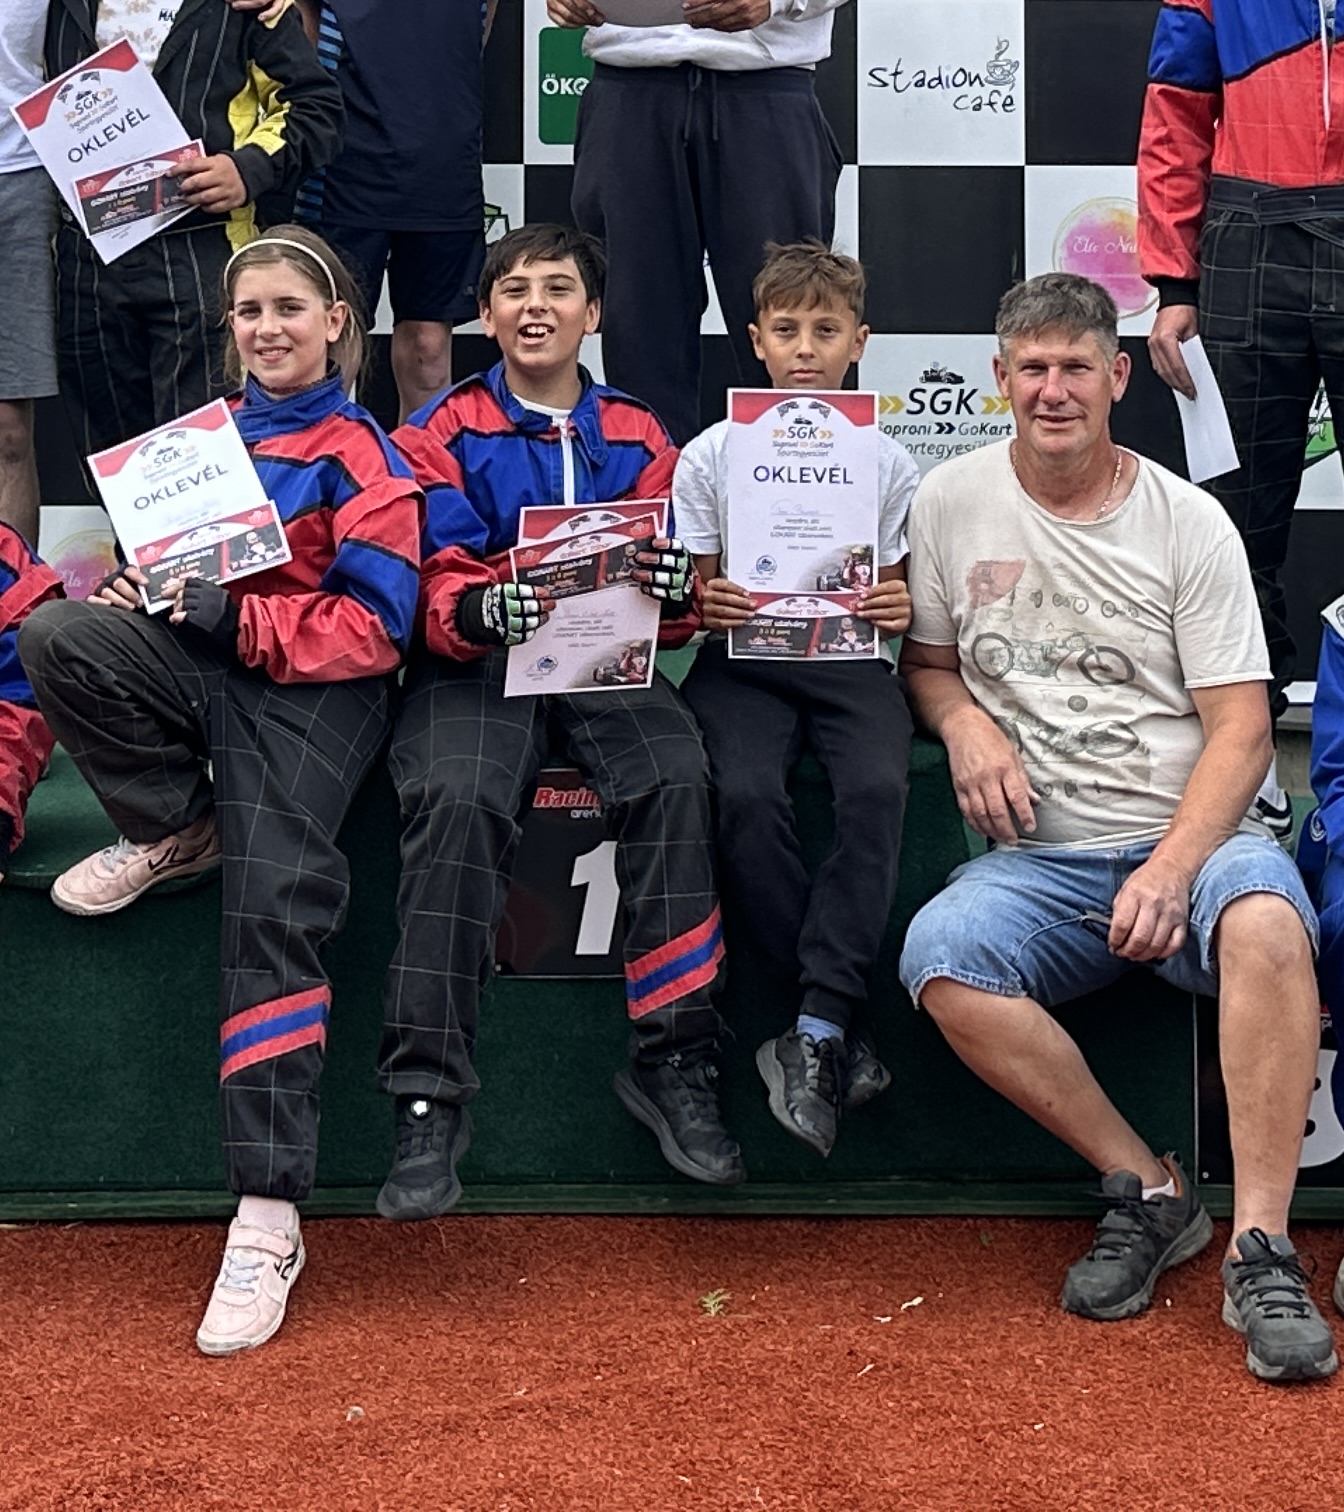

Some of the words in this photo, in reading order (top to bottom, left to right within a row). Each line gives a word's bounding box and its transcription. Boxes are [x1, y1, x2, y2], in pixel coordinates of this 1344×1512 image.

[541, 73, 589, 96] ÖKO
[74, 91, 103, 116] SGK
[67, 107, 151, 165] OKLEVÉL
[906, 387, 979, 416] SGK
[786, 426, 819, 439] SGK
[958, 421, 1013, 436] GoKart
[752, 463, 854, 485] OKLEVÉL
[133, 462, 229, 511] OKLEVÉL
[532, 786, 601, 809] Racin
[571, 840, 621, 956] 1
